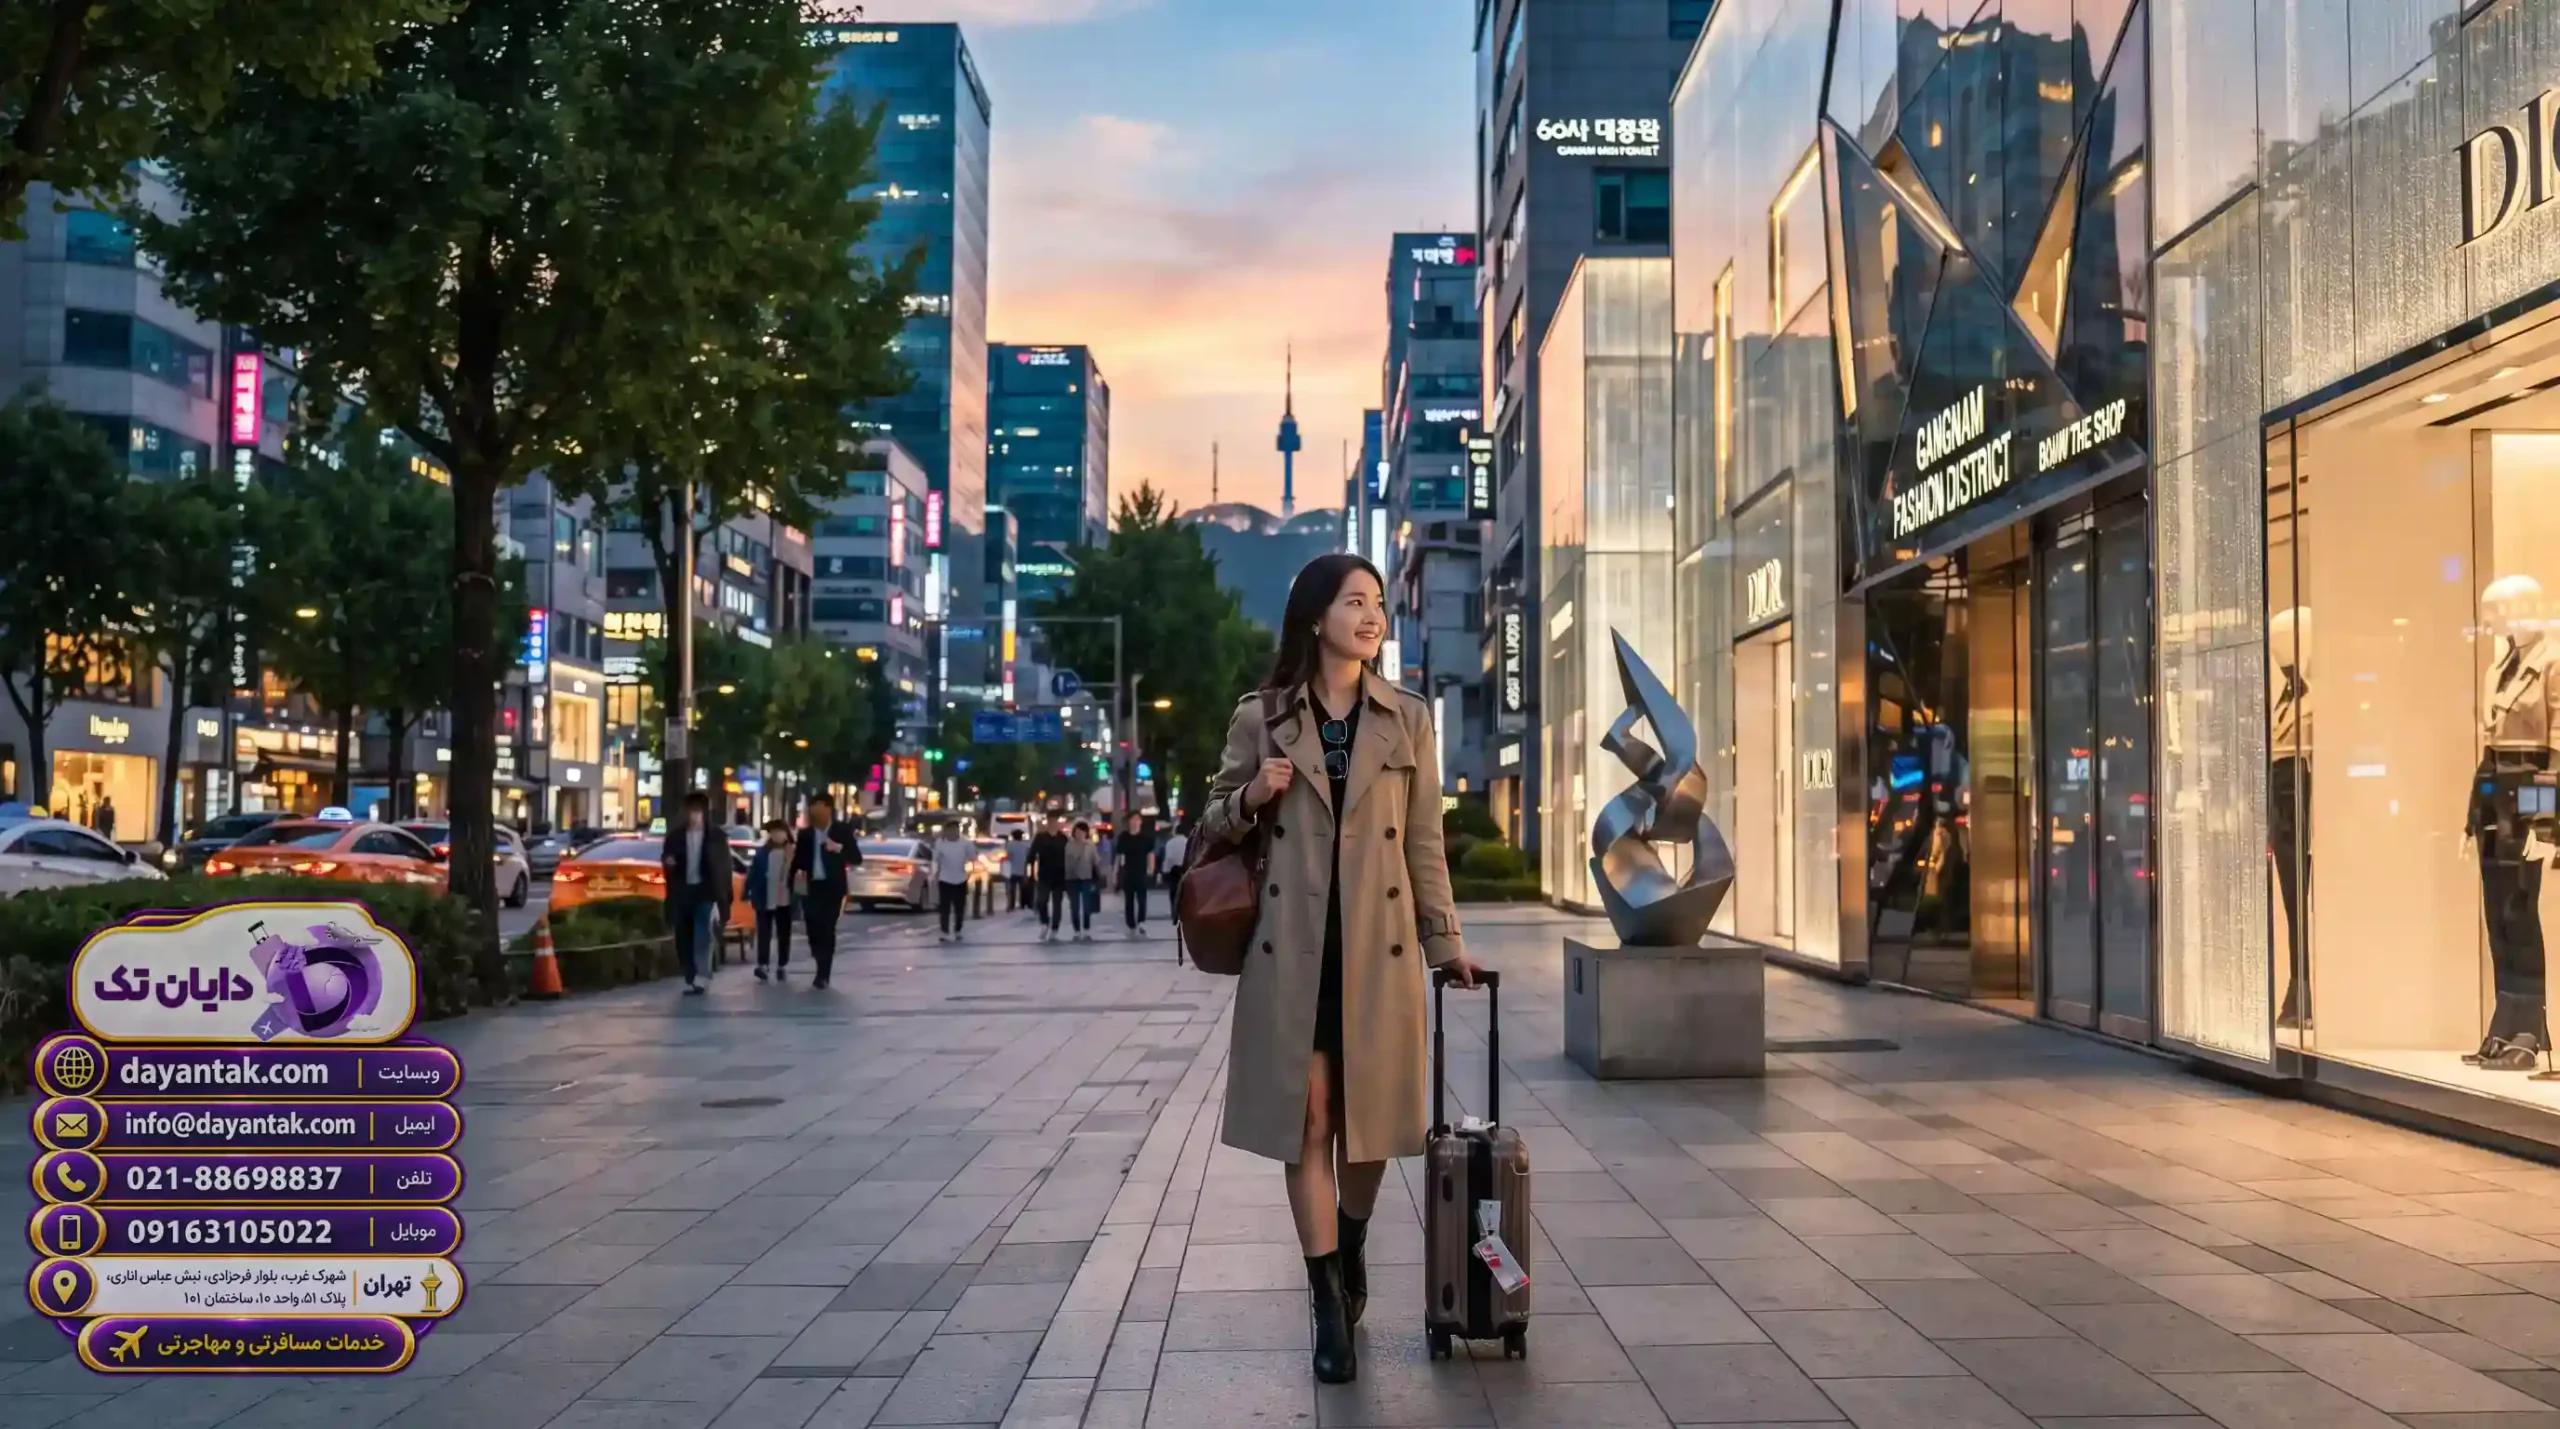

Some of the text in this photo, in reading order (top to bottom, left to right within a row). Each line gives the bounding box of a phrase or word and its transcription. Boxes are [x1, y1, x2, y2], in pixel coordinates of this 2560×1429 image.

[2453, 89, 2560, 249] DI
[1916, 384, 1985, 471] GANGNAM
[2069, 415, 2092, 455] THE
[2093, 398, 2126, 443] SHOP
[1893, 430, 2012, 540] FASHION DISTRICT
